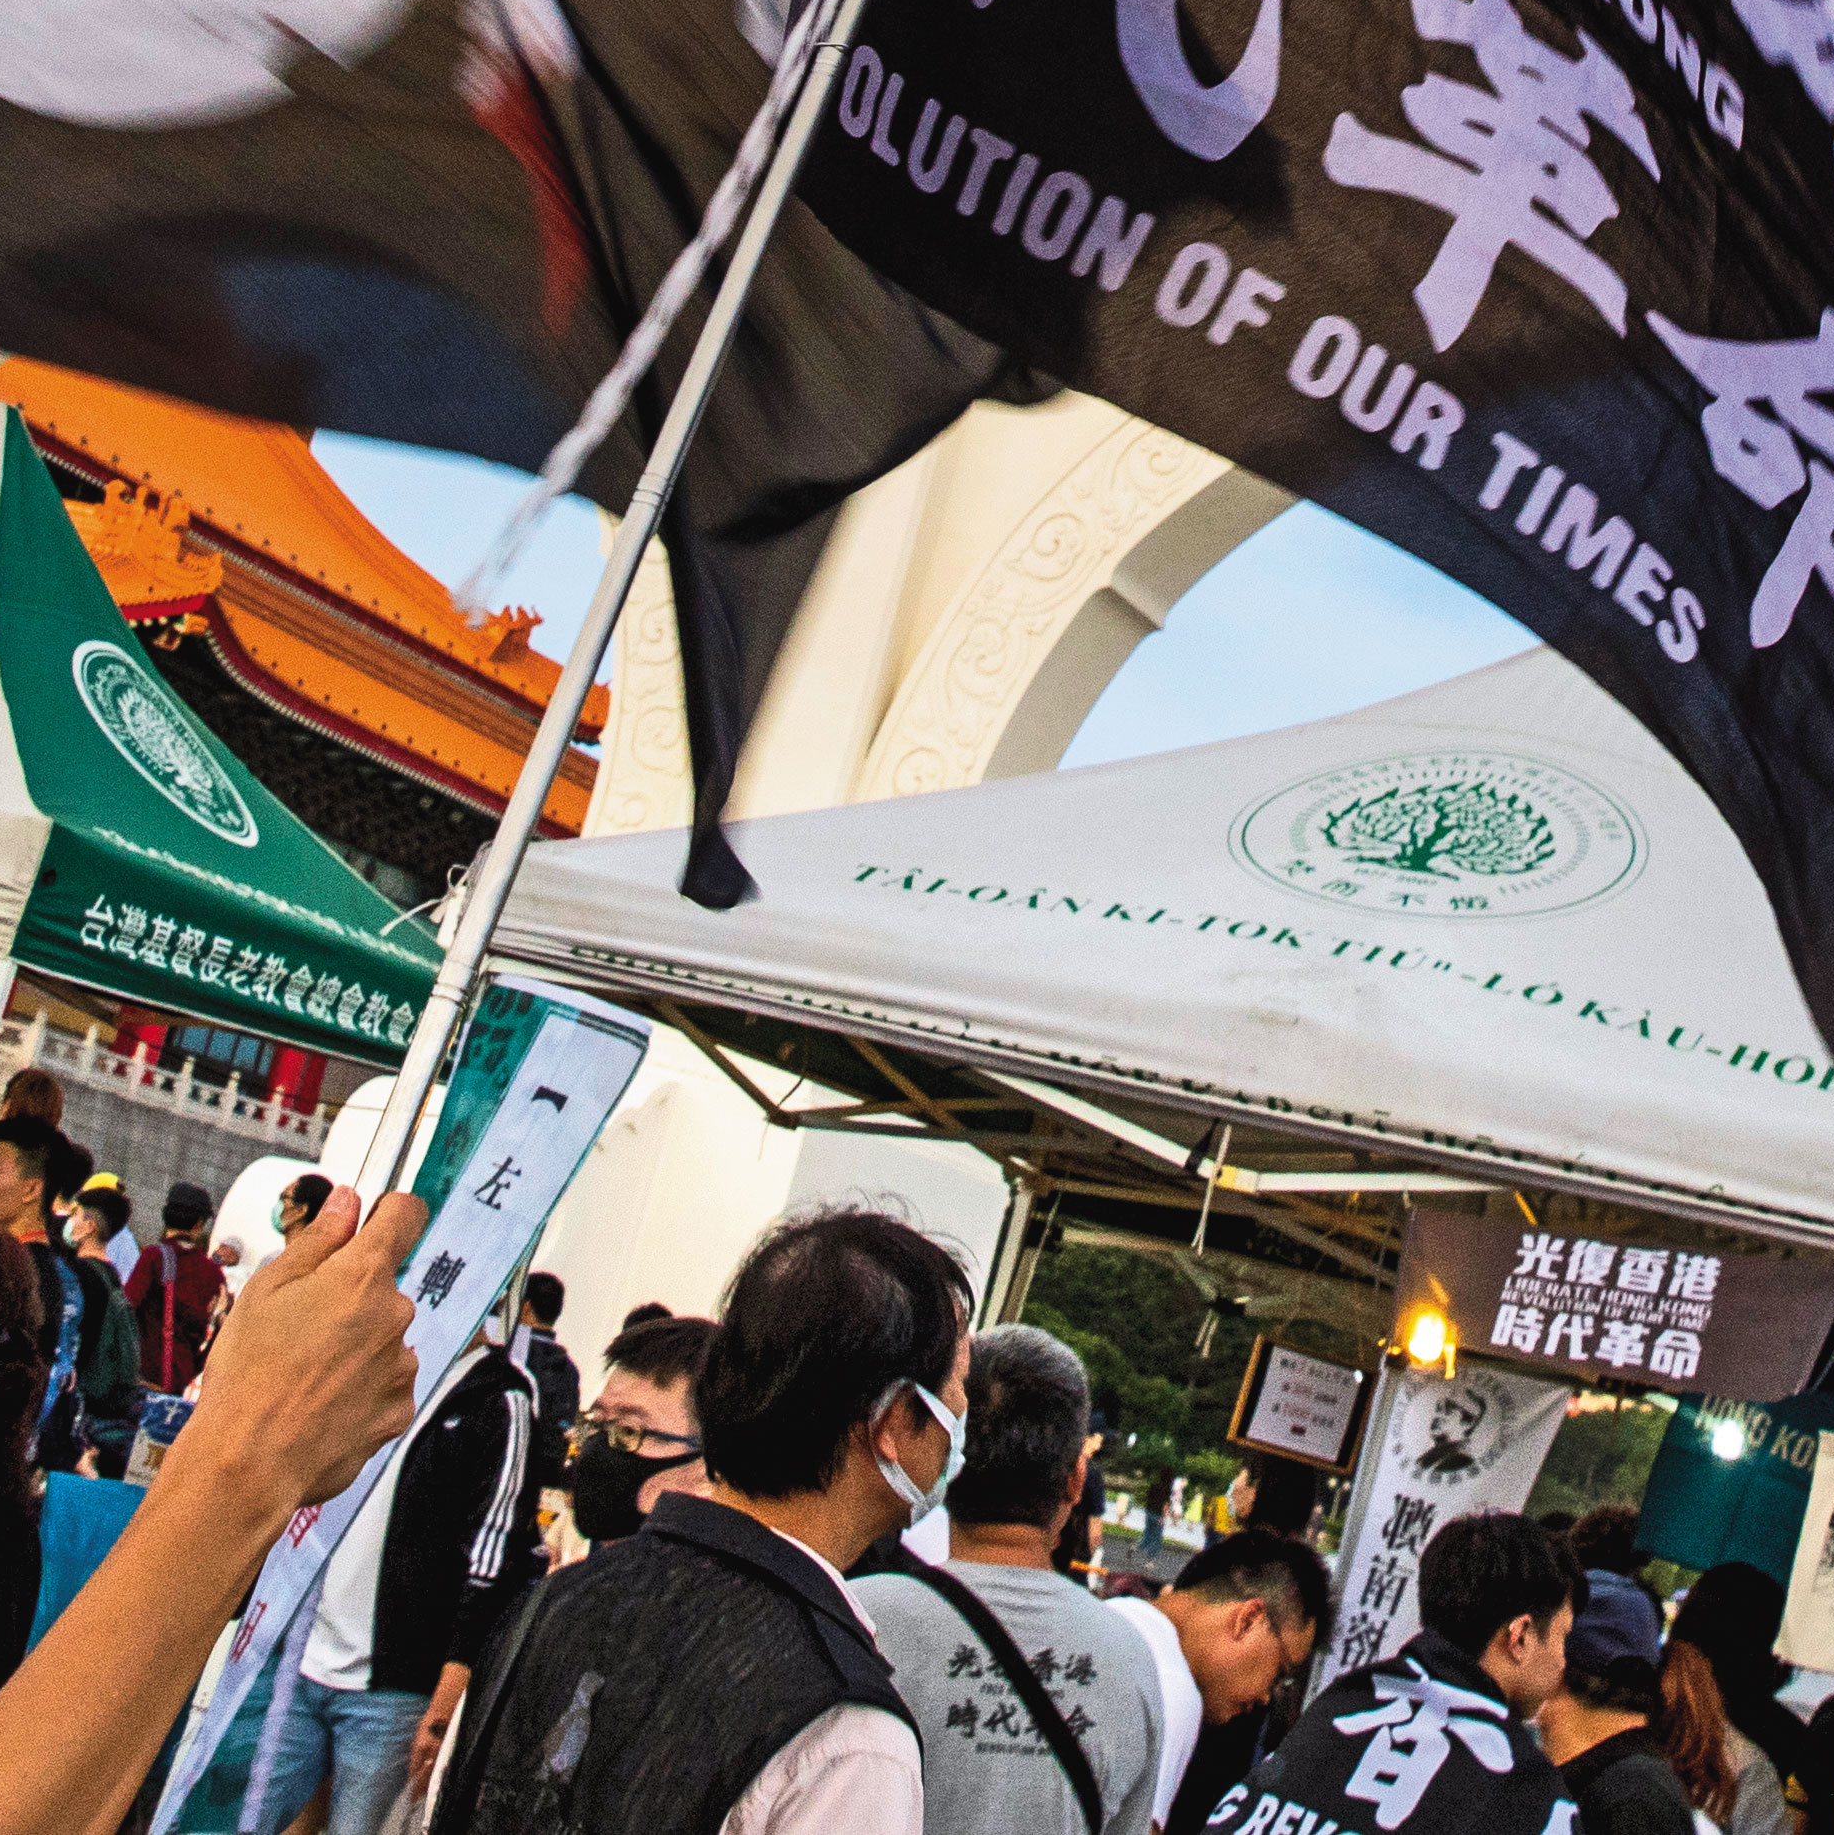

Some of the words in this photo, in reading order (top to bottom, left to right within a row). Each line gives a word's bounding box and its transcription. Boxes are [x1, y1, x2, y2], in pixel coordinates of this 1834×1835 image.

[839, 45, 1156, 292] OLUTION
[1154, 242, 1287, 345] OF
[1286, 314, 1467, 471] OUR
[1477, 431, 1706, 664] TIMES
[79, 894, 422, 1046] 台灣基督長老教會總會教會
[1512, 1232, 1722, 1301] 光復香港
[1599, 1288, 1654, 1310] HONG
[1658, 1298, 1713, 1319] KONG
[1490, 1302, 1702, 1380] 時代革命
[1769, 1424, 1817, 1473] KO
